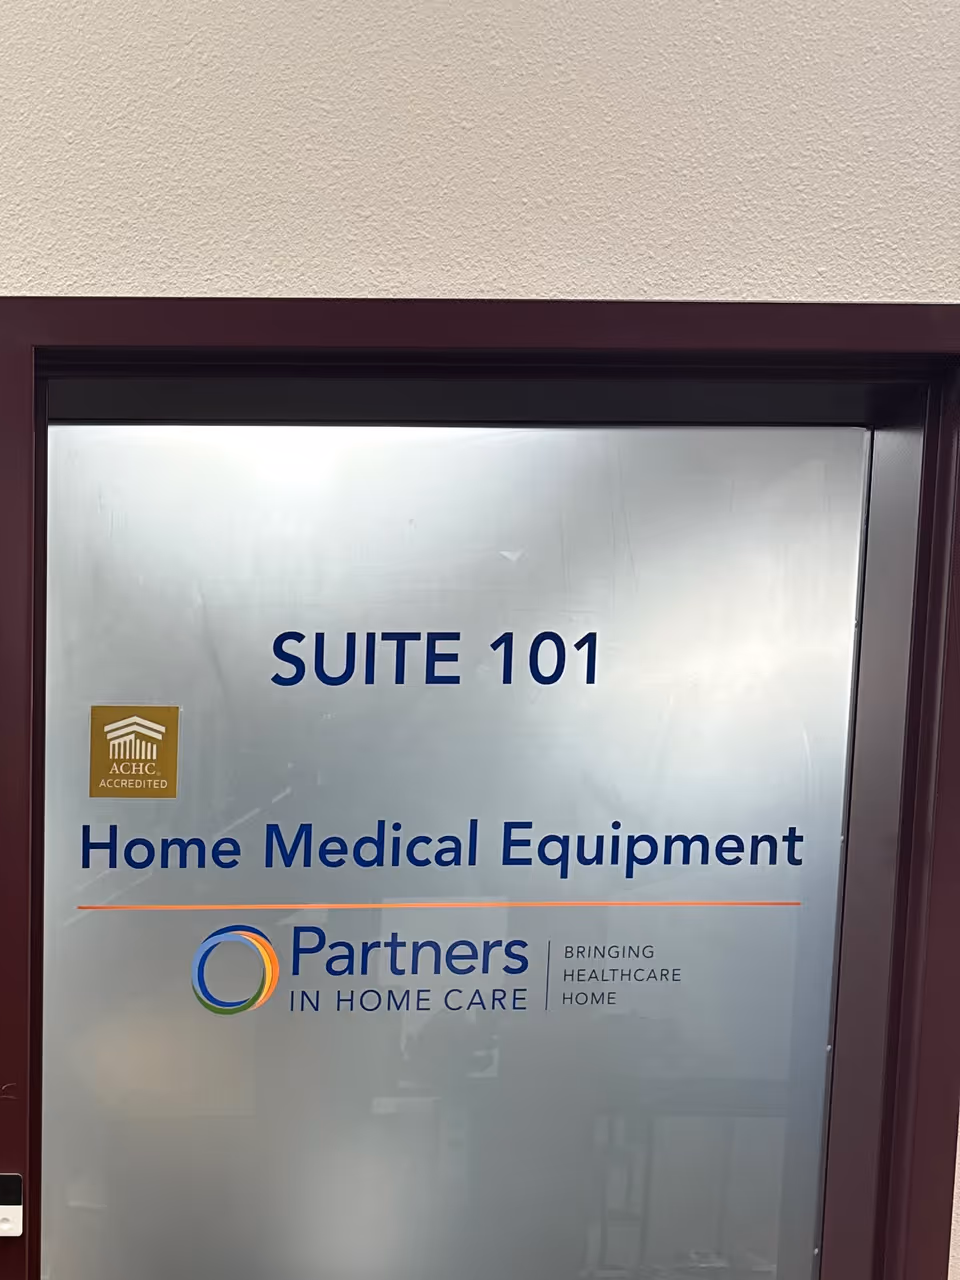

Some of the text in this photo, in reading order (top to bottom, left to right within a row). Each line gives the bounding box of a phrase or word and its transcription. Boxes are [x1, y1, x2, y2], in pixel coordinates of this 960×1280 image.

[270, 631, 600, 687] SUITE 101
[109, 762, 156, 775] ACHC
[99, 779, 168, 789] ACCREDITED
[81, 819, 804, 879] Home Medical Equipment
[291, 926, 529, 976] Partners
[564, 945, 655, 959] BRINGING
[563, 968, 682, 982] HEALTHCARE
[290, 989, 527, 1012] IN HOME CARE
[562, 992, 617, 1006] HOME
